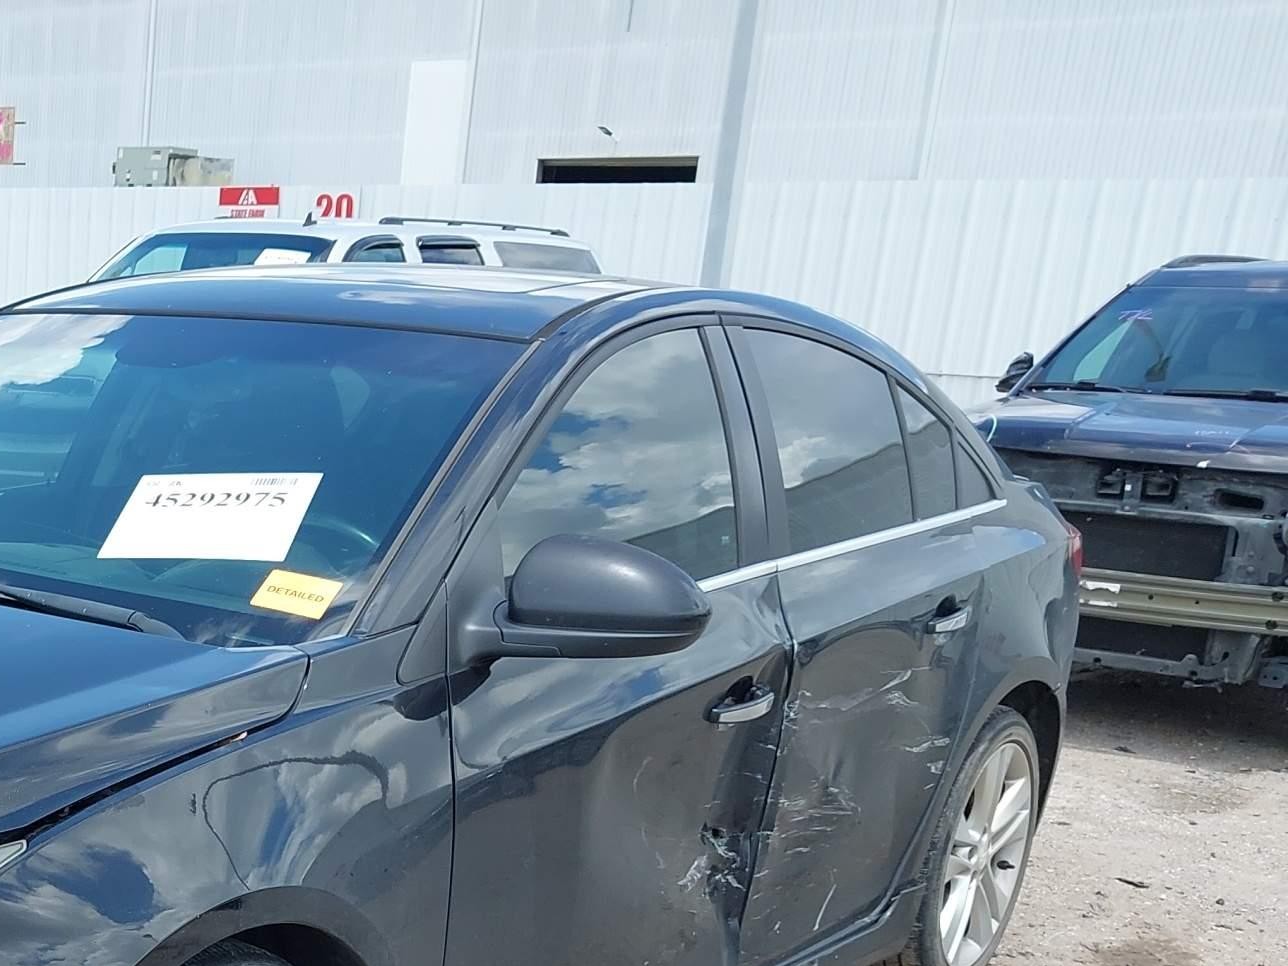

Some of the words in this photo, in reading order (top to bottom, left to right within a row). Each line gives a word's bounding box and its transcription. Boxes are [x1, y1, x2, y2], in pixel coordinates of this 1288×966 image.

[316, 193, 354, 218] 20
[145, 492, 289, 508] 45292975
[266, 585, 325, 603] DETAILED
